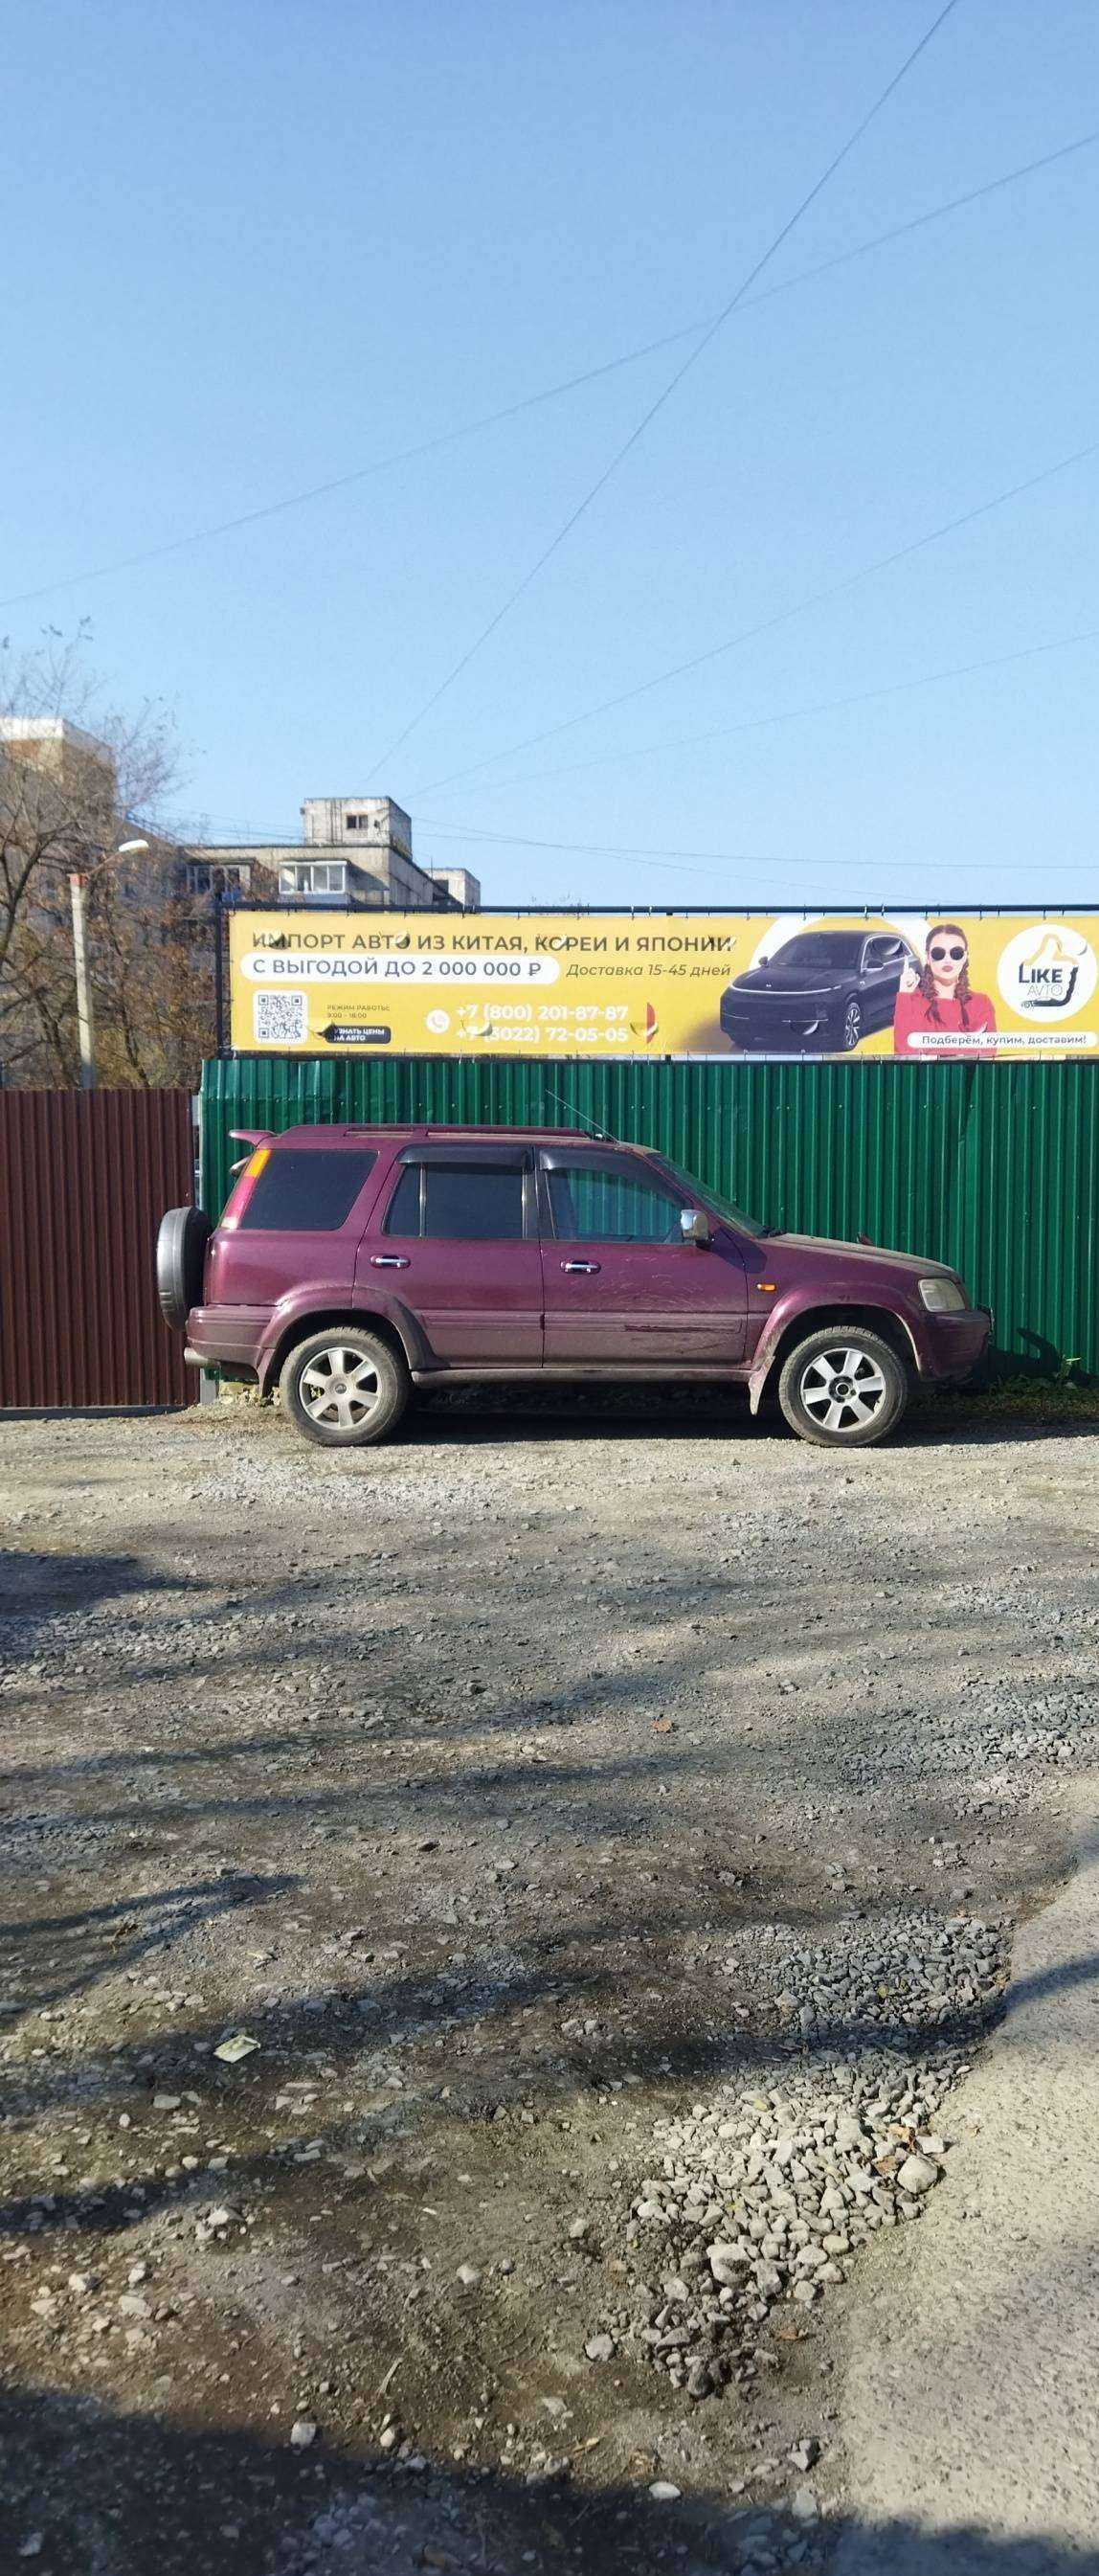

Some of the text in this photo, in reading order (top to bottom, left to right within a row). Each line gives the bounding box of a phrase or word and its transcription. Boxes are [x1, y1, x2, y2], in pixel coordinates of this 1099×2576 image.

[351, 933, 411, 949] АВТО
[417, 935, 445, 950] ИЗ
[452, 935, 528, 953] КИТАЯ,
[535, 935, 608, 951] КОРЕИ
[615, 937, 630, 951] И
[637, 937, 732, 952] ЯПОНИИ
[253, 959, 266, 974] С
[273, 957, 378, 977] ВЫГОДОЙ
[385, 960, 415, 977] ДО
[422, 960, 433, 976] 2
[438, 960, 477, 976] 000
[483, 961, 522, 976] 000
[566, 963, 731, 978] Доставка 15-45 дней
[1018, 962, 1064, 983] LIKE
[456, 1005, 629, 1022] +7 (800) 201-87-87
[546, 1028, 629, 1042] 72-05-05
[921, 1034, 1087, 1047] Подберём, купим, доставим!
